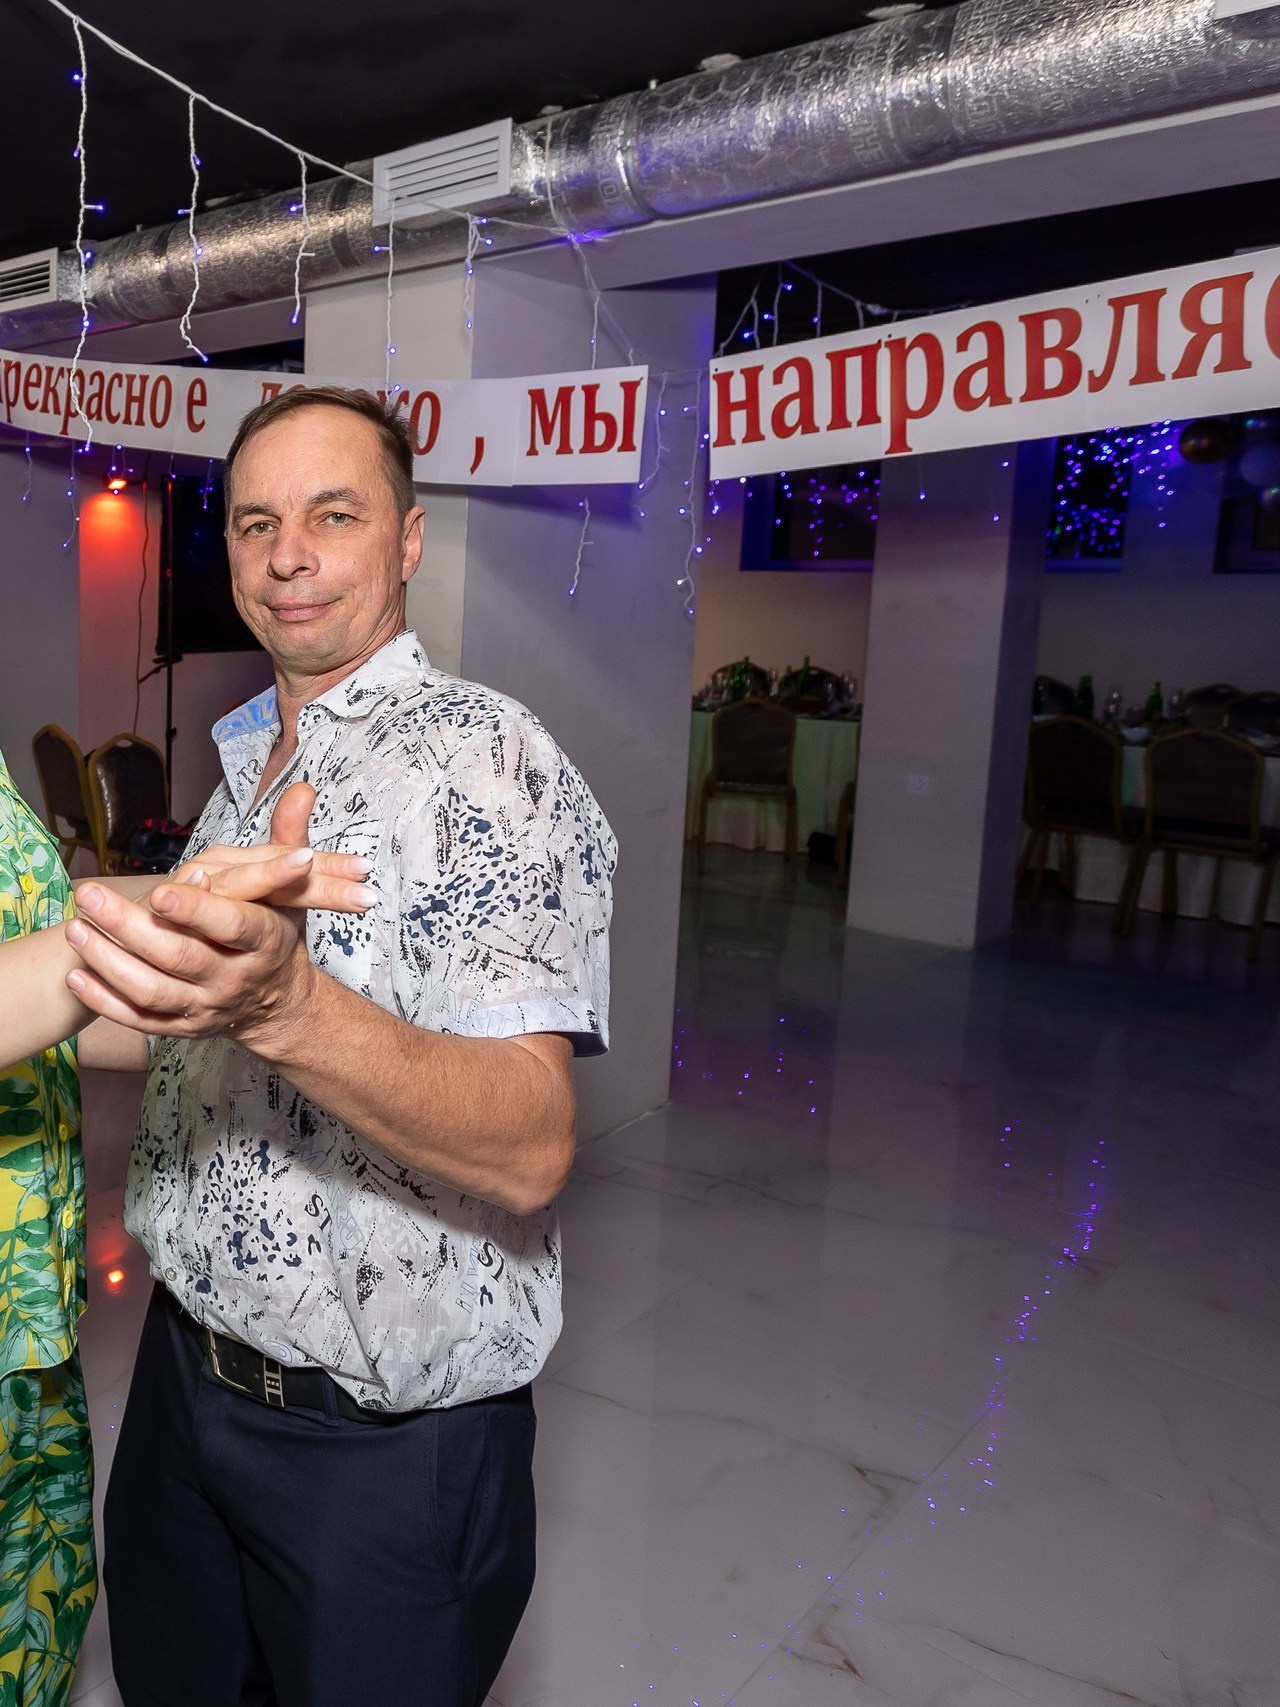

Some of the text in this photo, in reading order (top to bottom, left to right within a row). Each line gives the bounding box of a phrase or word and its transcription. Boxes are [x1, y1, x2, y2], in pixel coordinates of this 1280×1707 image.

[712, 271, 1280, 456] направля
[527, 380, 641, 456] мы
[304, 1193, 333, 1233] ST
[477, 1241, 505, 1283] ST
